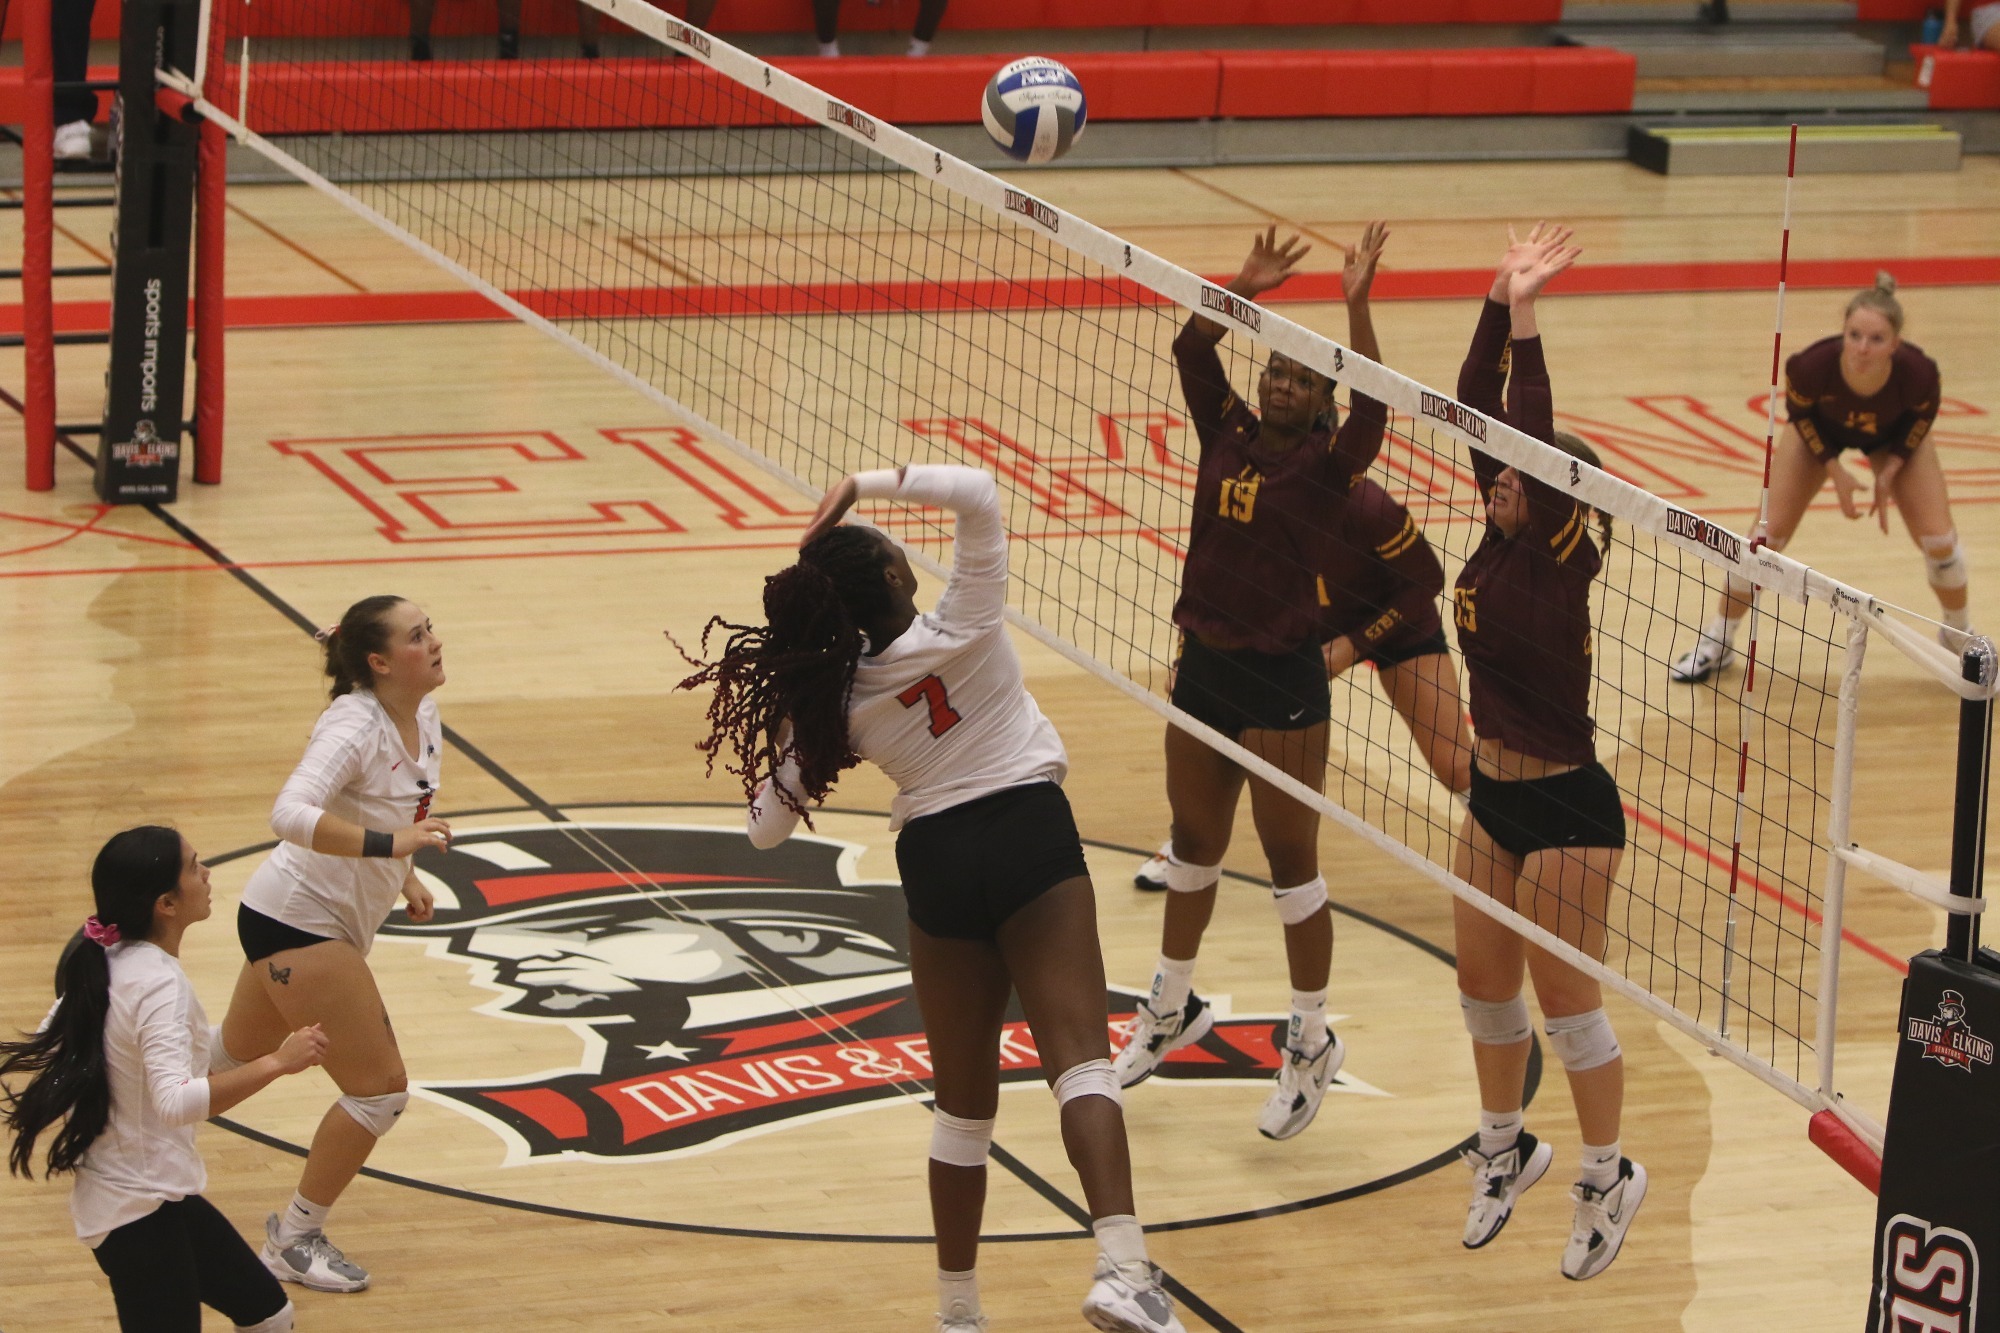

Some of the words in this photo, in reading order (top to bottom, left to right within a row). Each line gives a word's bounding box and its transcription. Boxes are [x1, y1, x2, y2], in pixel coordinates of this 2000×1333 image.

[143, 278, 162, 338] sports
[140, 339, 159, 412] imports
[1218, 477, 1260, 523] 19
[894, 673, 963, 740] 7
[1934, 1045, 1961, 1058] SENATORS
[620, 1054, 836, 1123] DAVIS
